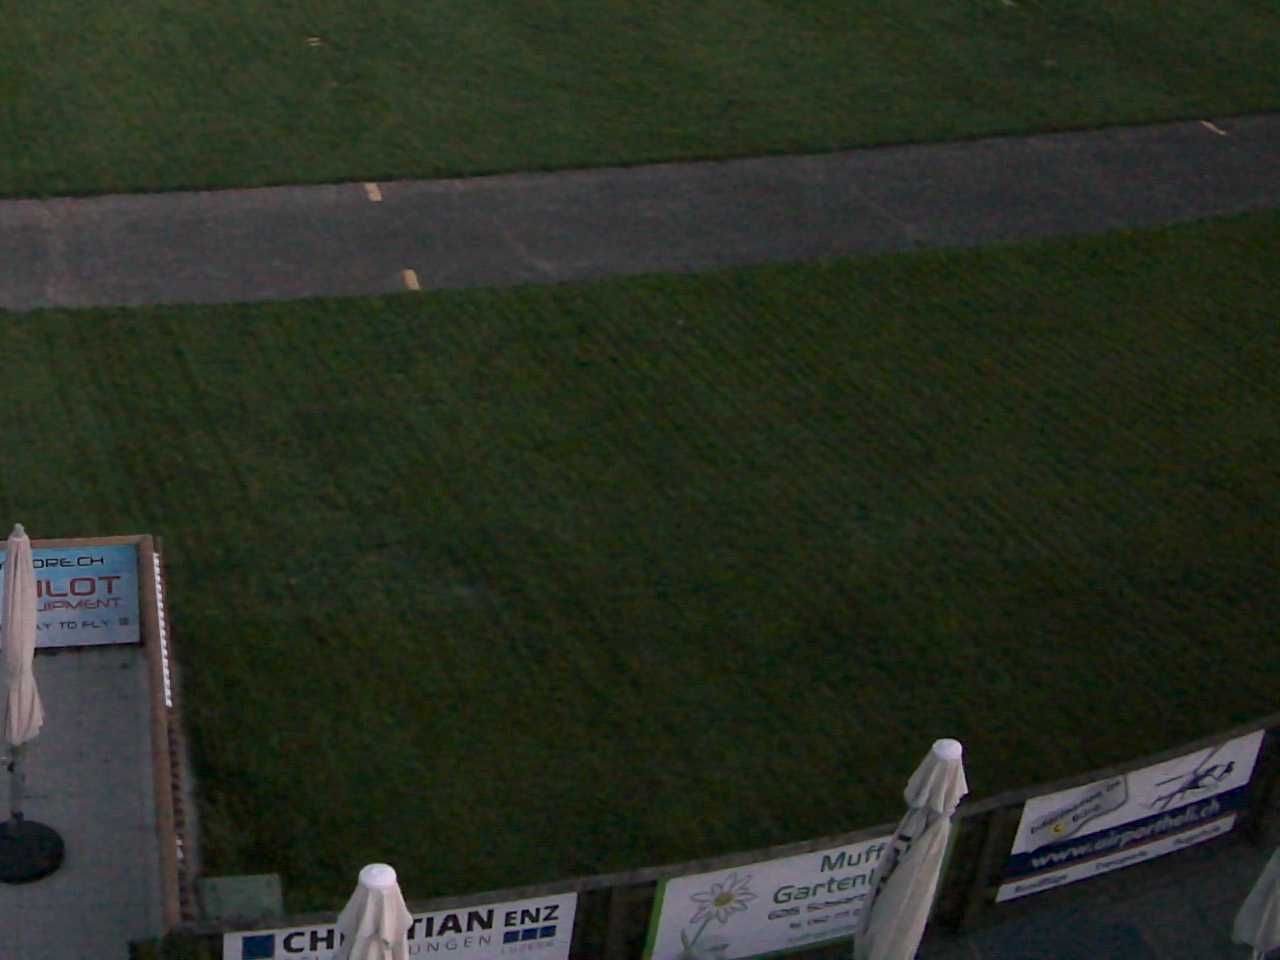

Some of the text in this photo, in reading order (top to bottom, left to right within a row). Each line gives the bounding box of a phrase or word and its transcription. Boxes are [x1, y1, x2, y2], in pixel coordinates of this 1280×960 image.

[37, 575, 121, 598] ILOT
[37, 598, 122, 612] UIPMENT
[283, 904, 560, 954] CHTIAN ENZ
